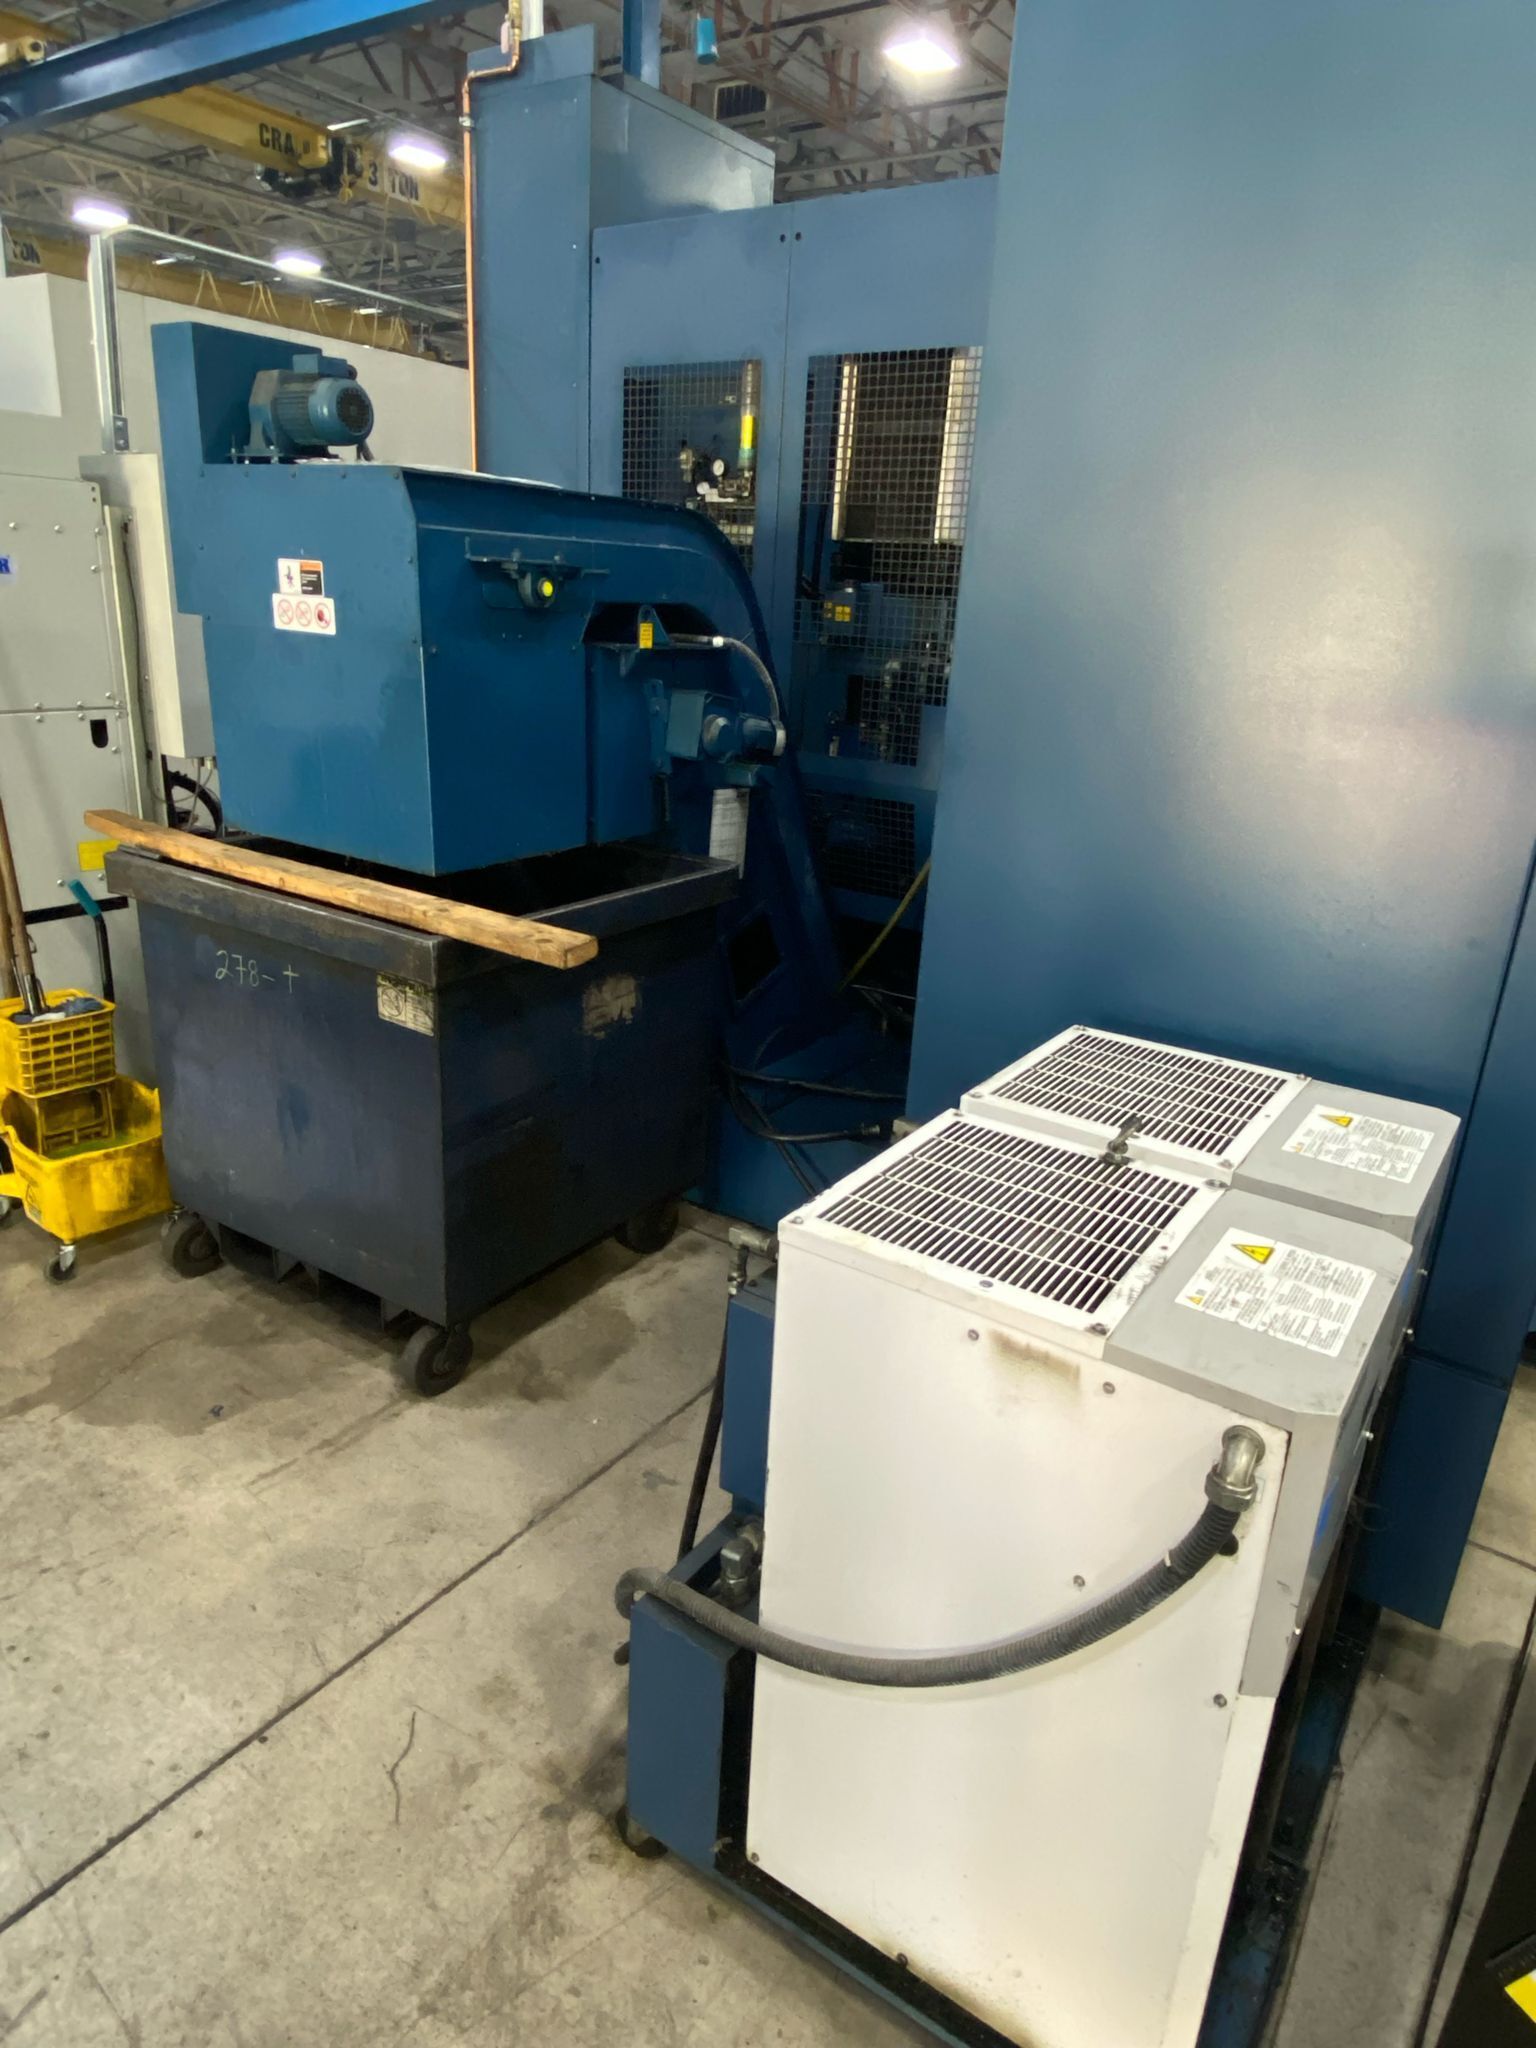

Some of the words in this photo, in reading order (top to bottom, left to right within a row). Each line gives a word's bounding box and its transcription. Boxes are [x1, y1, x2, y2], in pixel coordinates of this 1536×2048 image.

[259, 123, 296, 157] CRA
[368, 160, 378, 186] 3
[388, 167, 419, 201] TON
